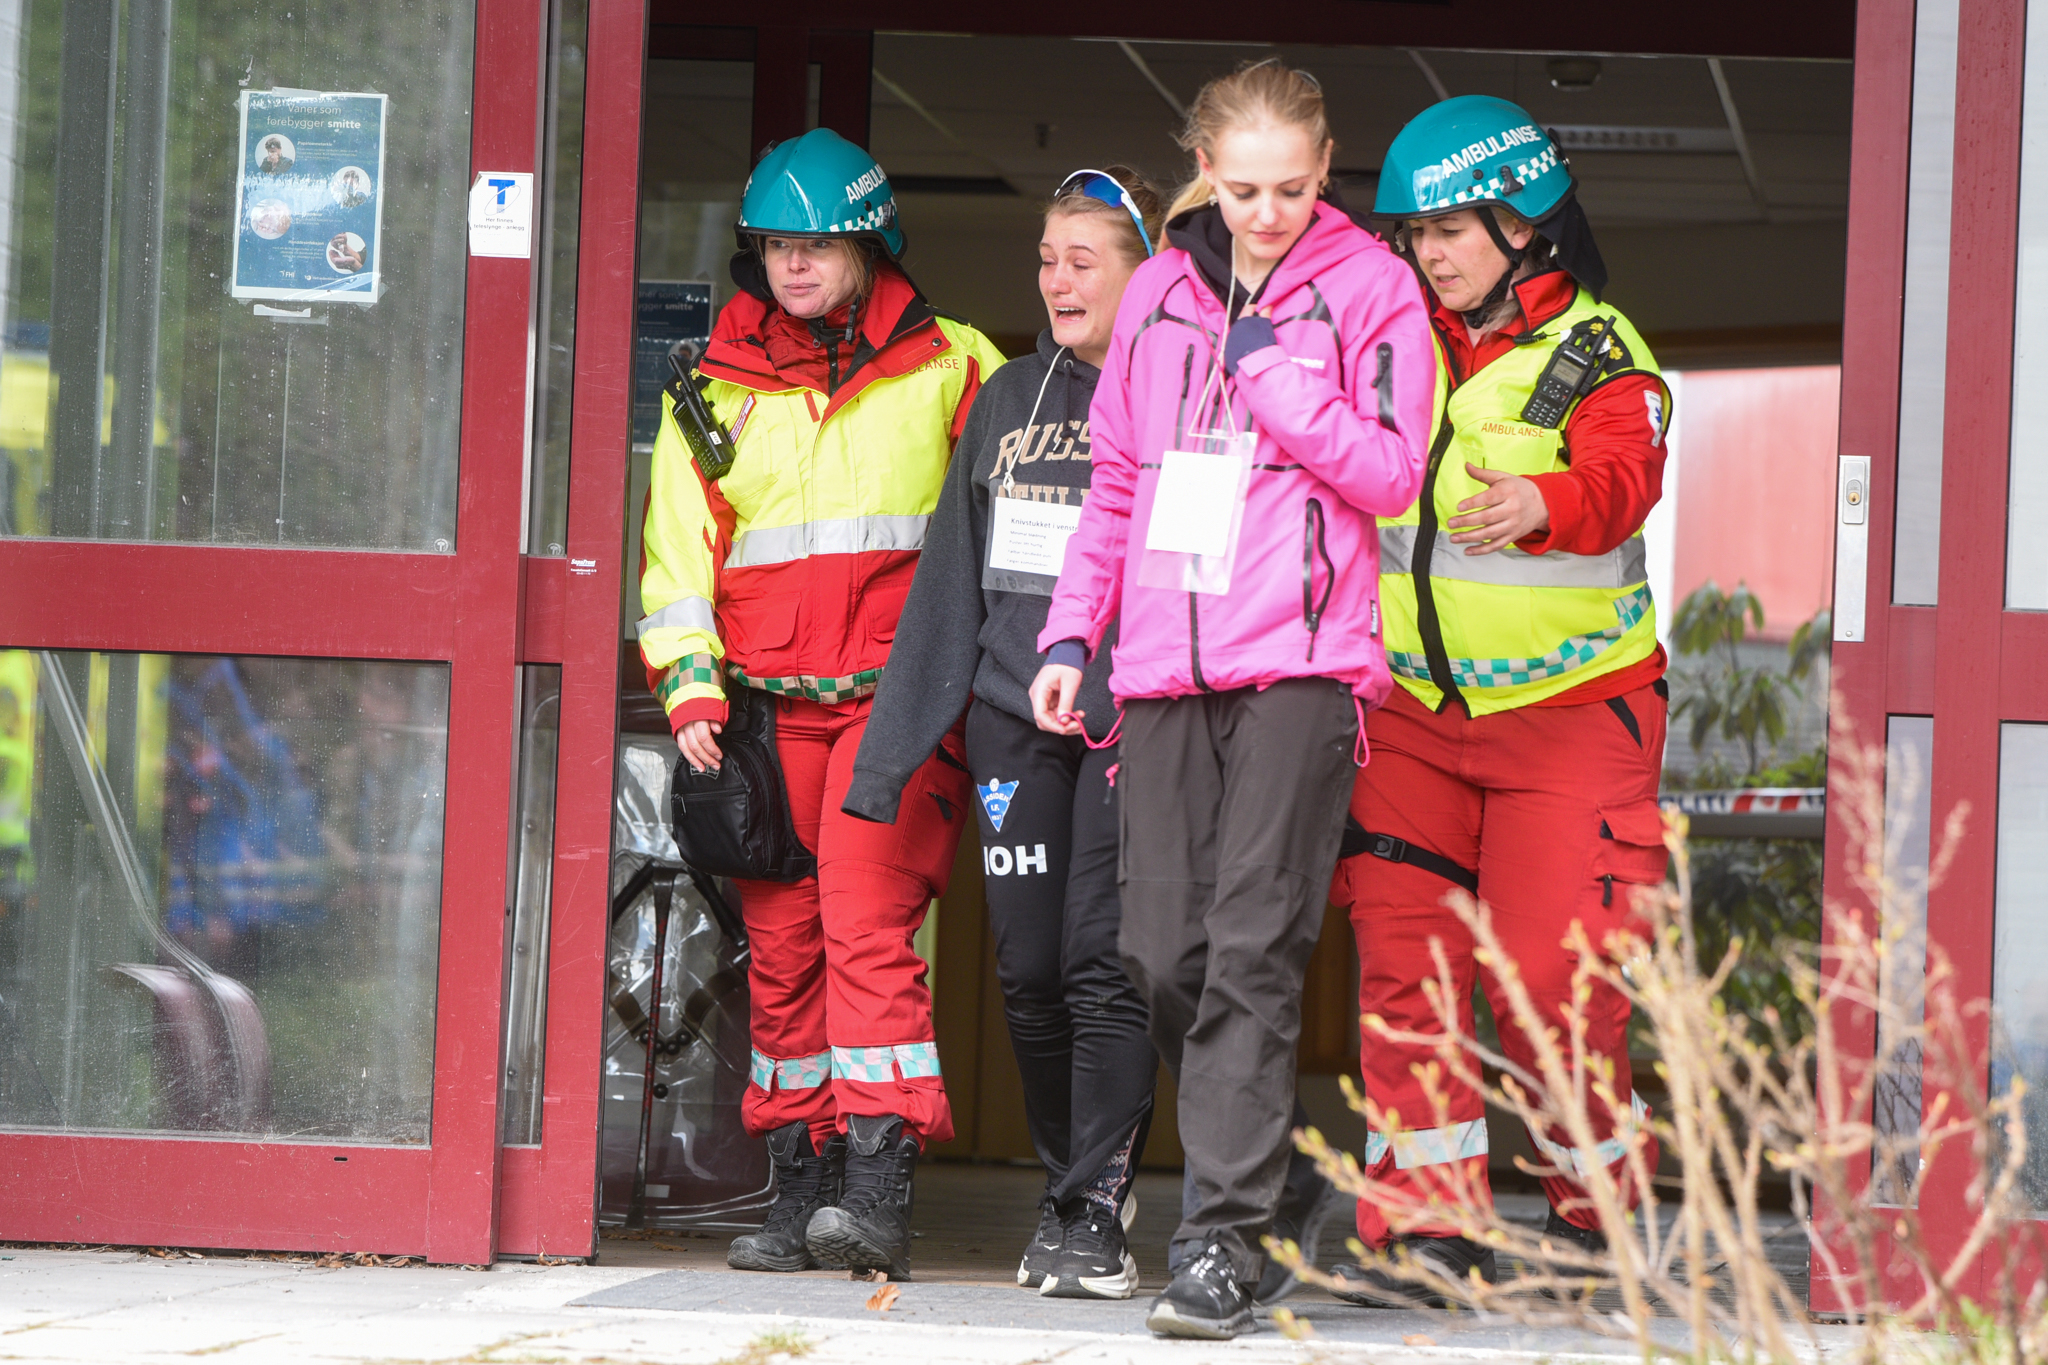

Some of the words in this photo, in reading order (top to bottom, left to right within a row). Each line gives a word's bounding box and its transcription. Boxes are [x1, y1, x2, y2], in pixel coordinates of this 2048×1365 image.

[288, 103, 317, 113] Vaner
[320, 106, 342, 114] som
[267, 115, 325, 129] forebygger
[327, 119, 361, 129] smitte
[1441, 125, 1542, 179] AMBULANSE
[665, 302, 694, 311] smitte
[1481, 422, 1545, 438] AMBULANSE
[1010, 517, 1051, 529] Knivstukket
